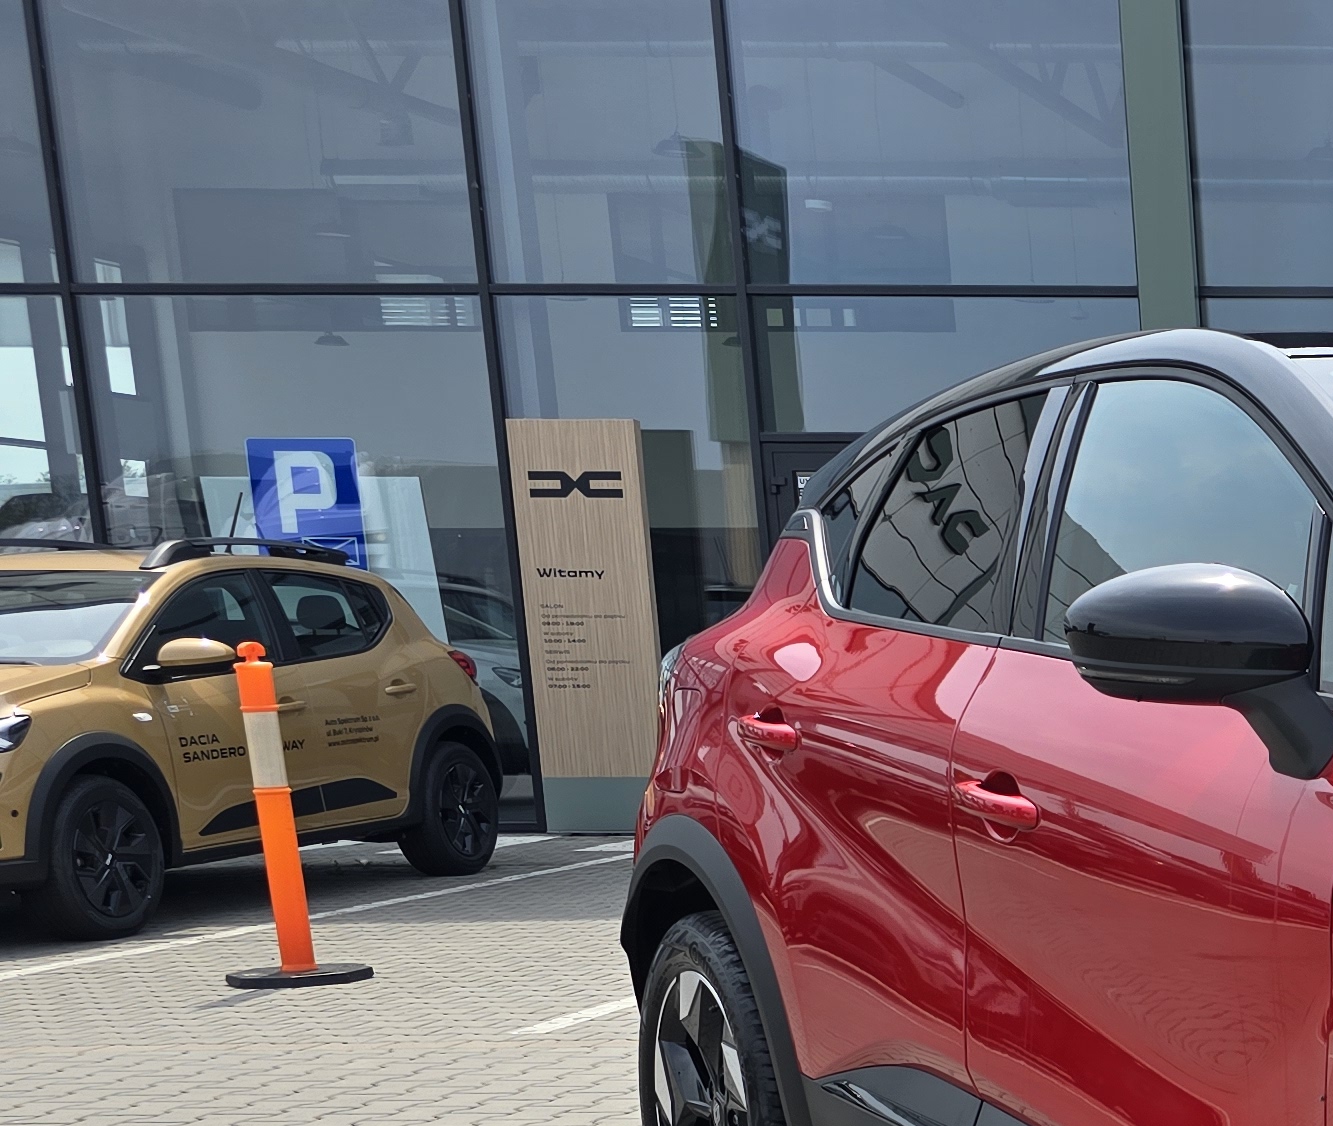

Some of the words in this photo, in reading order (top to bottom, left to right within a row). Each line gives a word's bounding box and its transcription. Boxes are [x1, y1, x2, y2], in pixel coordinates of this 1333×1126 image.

[273, 450, 337, 534] P
[536, 567, 605, 580] Witamy
[178, 733, 221, 748] DACIA
[182, 745, 247, 764] SANDERO
